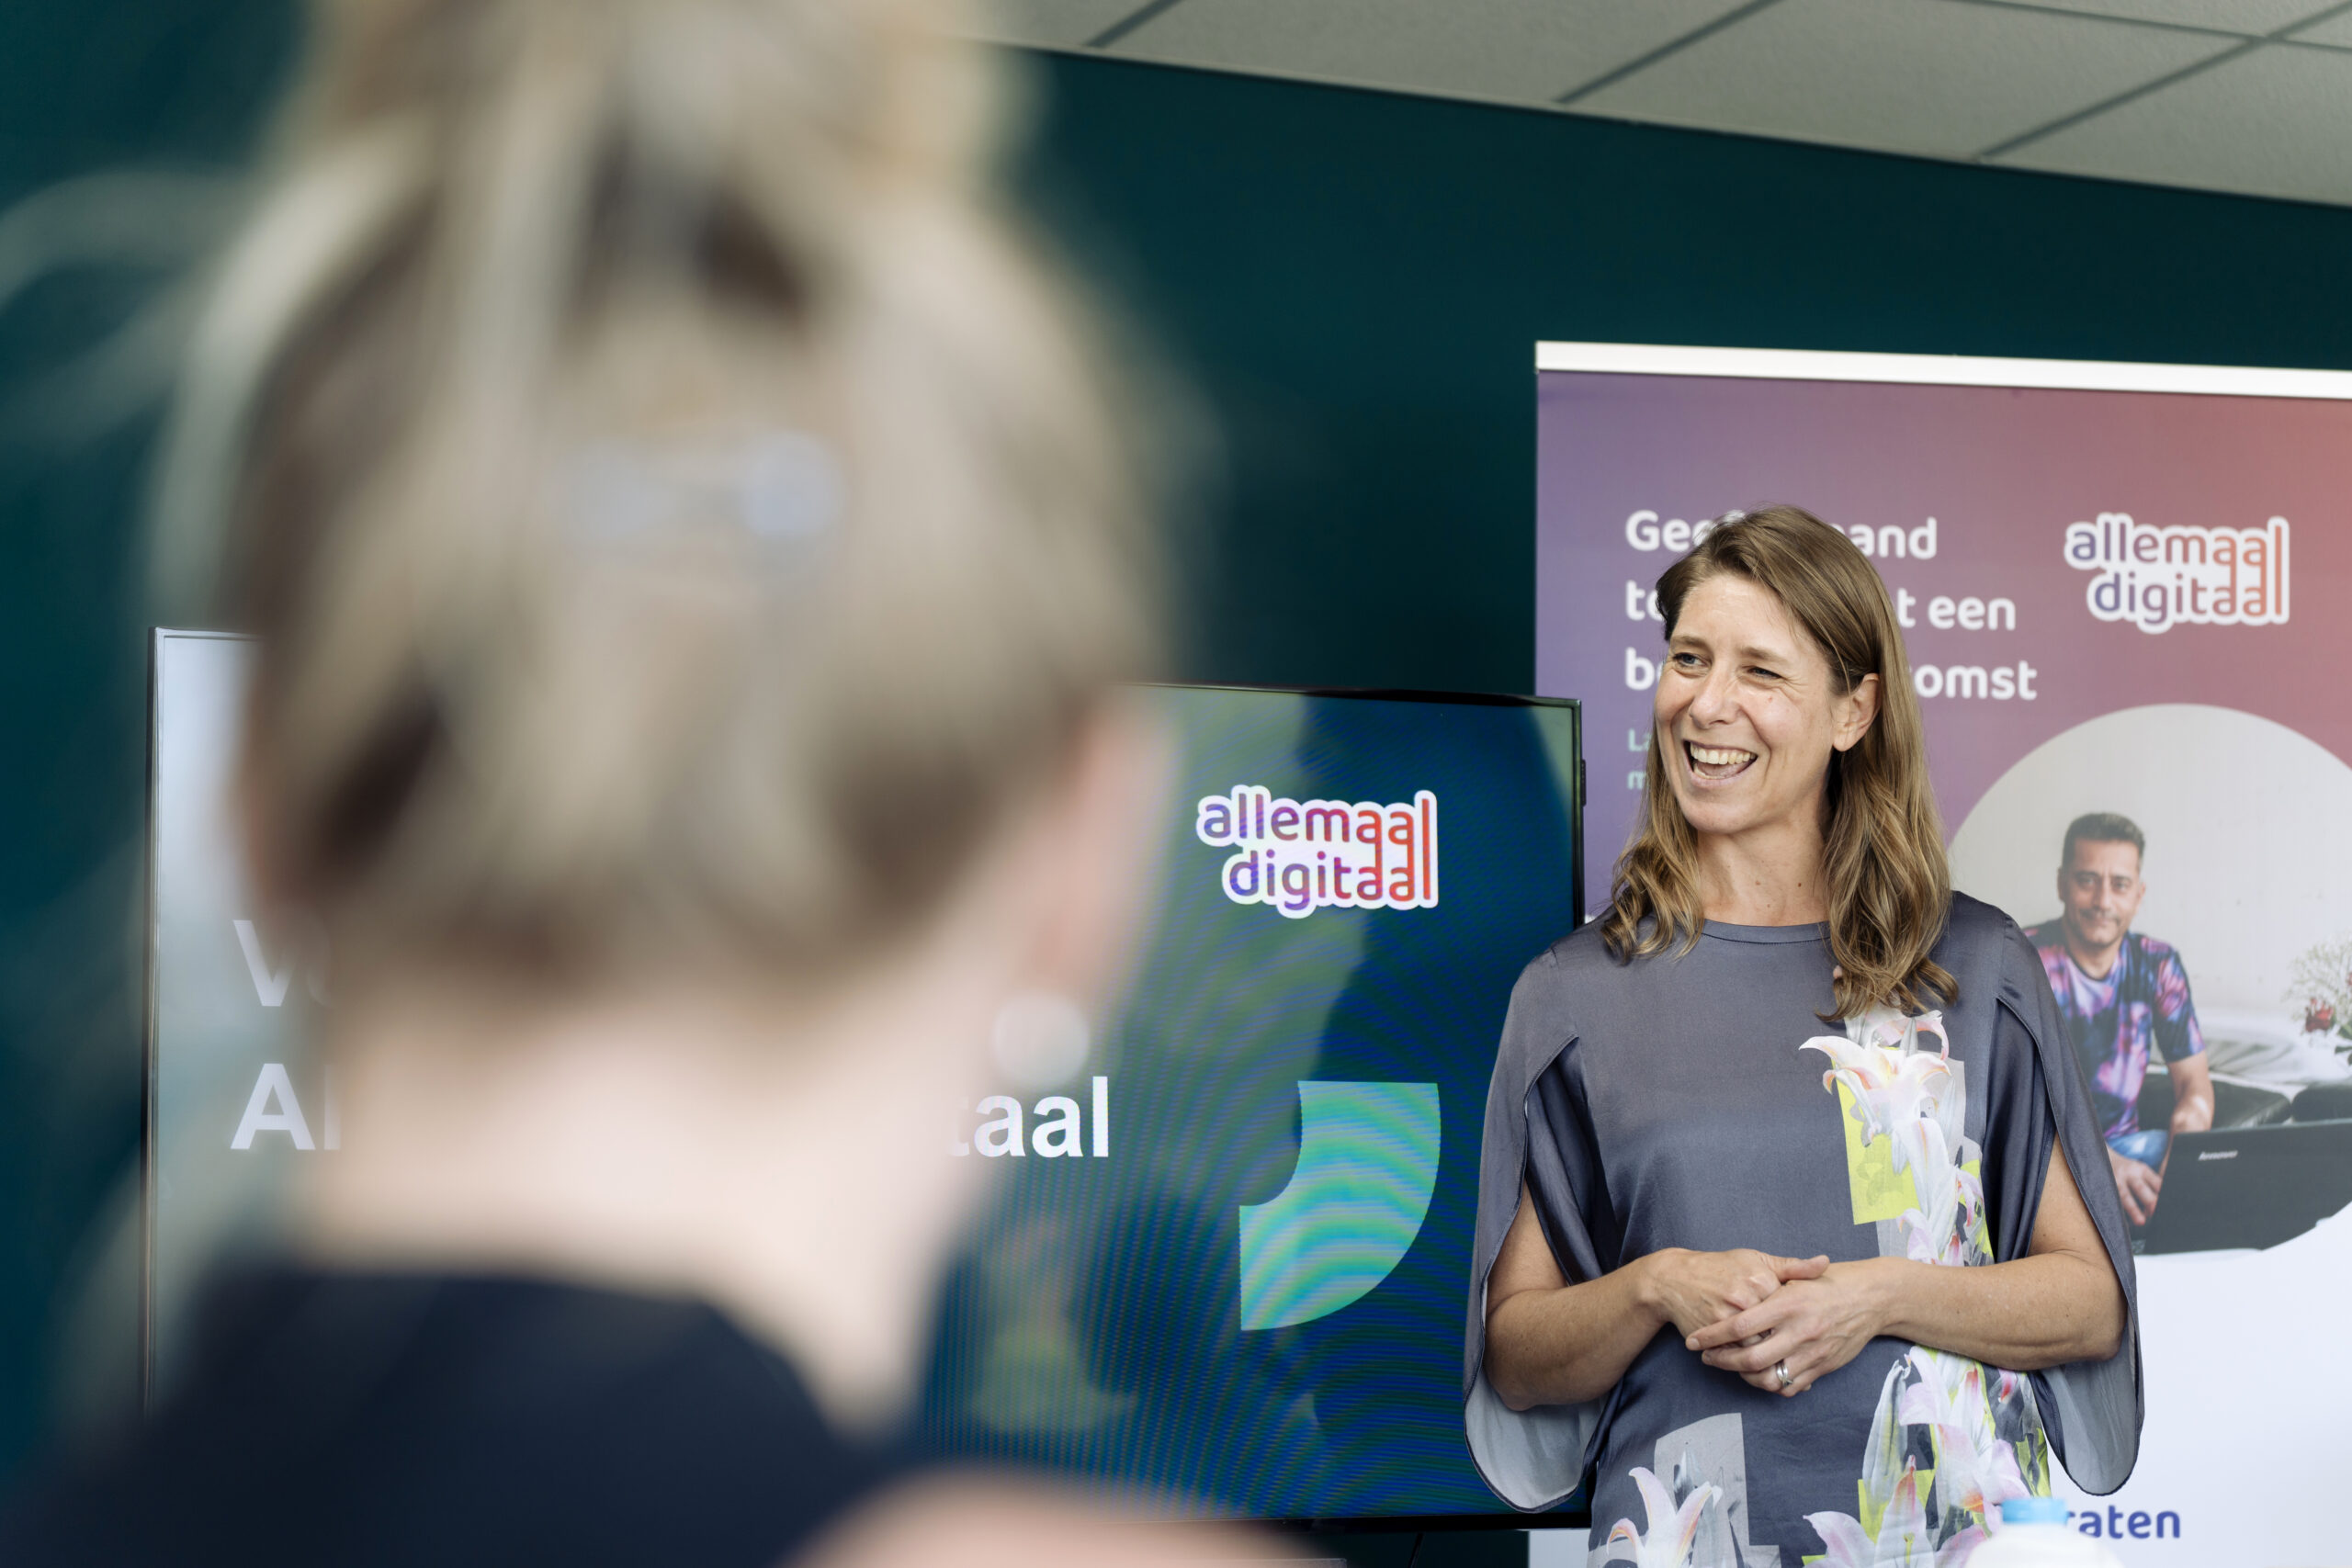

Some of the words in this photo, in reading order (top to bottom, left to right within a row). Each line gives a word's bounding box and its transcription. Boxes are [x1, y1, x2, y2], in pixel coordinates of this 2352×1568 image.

[2071, 520, 2283, 568] allemaal
[1928, 595, 2018, 631] een
[2094, 570, 2283, 626] digitaal
[1203, 792, 1430, 845] allemaal
[1228, 847, 1430, 911] digitaal
